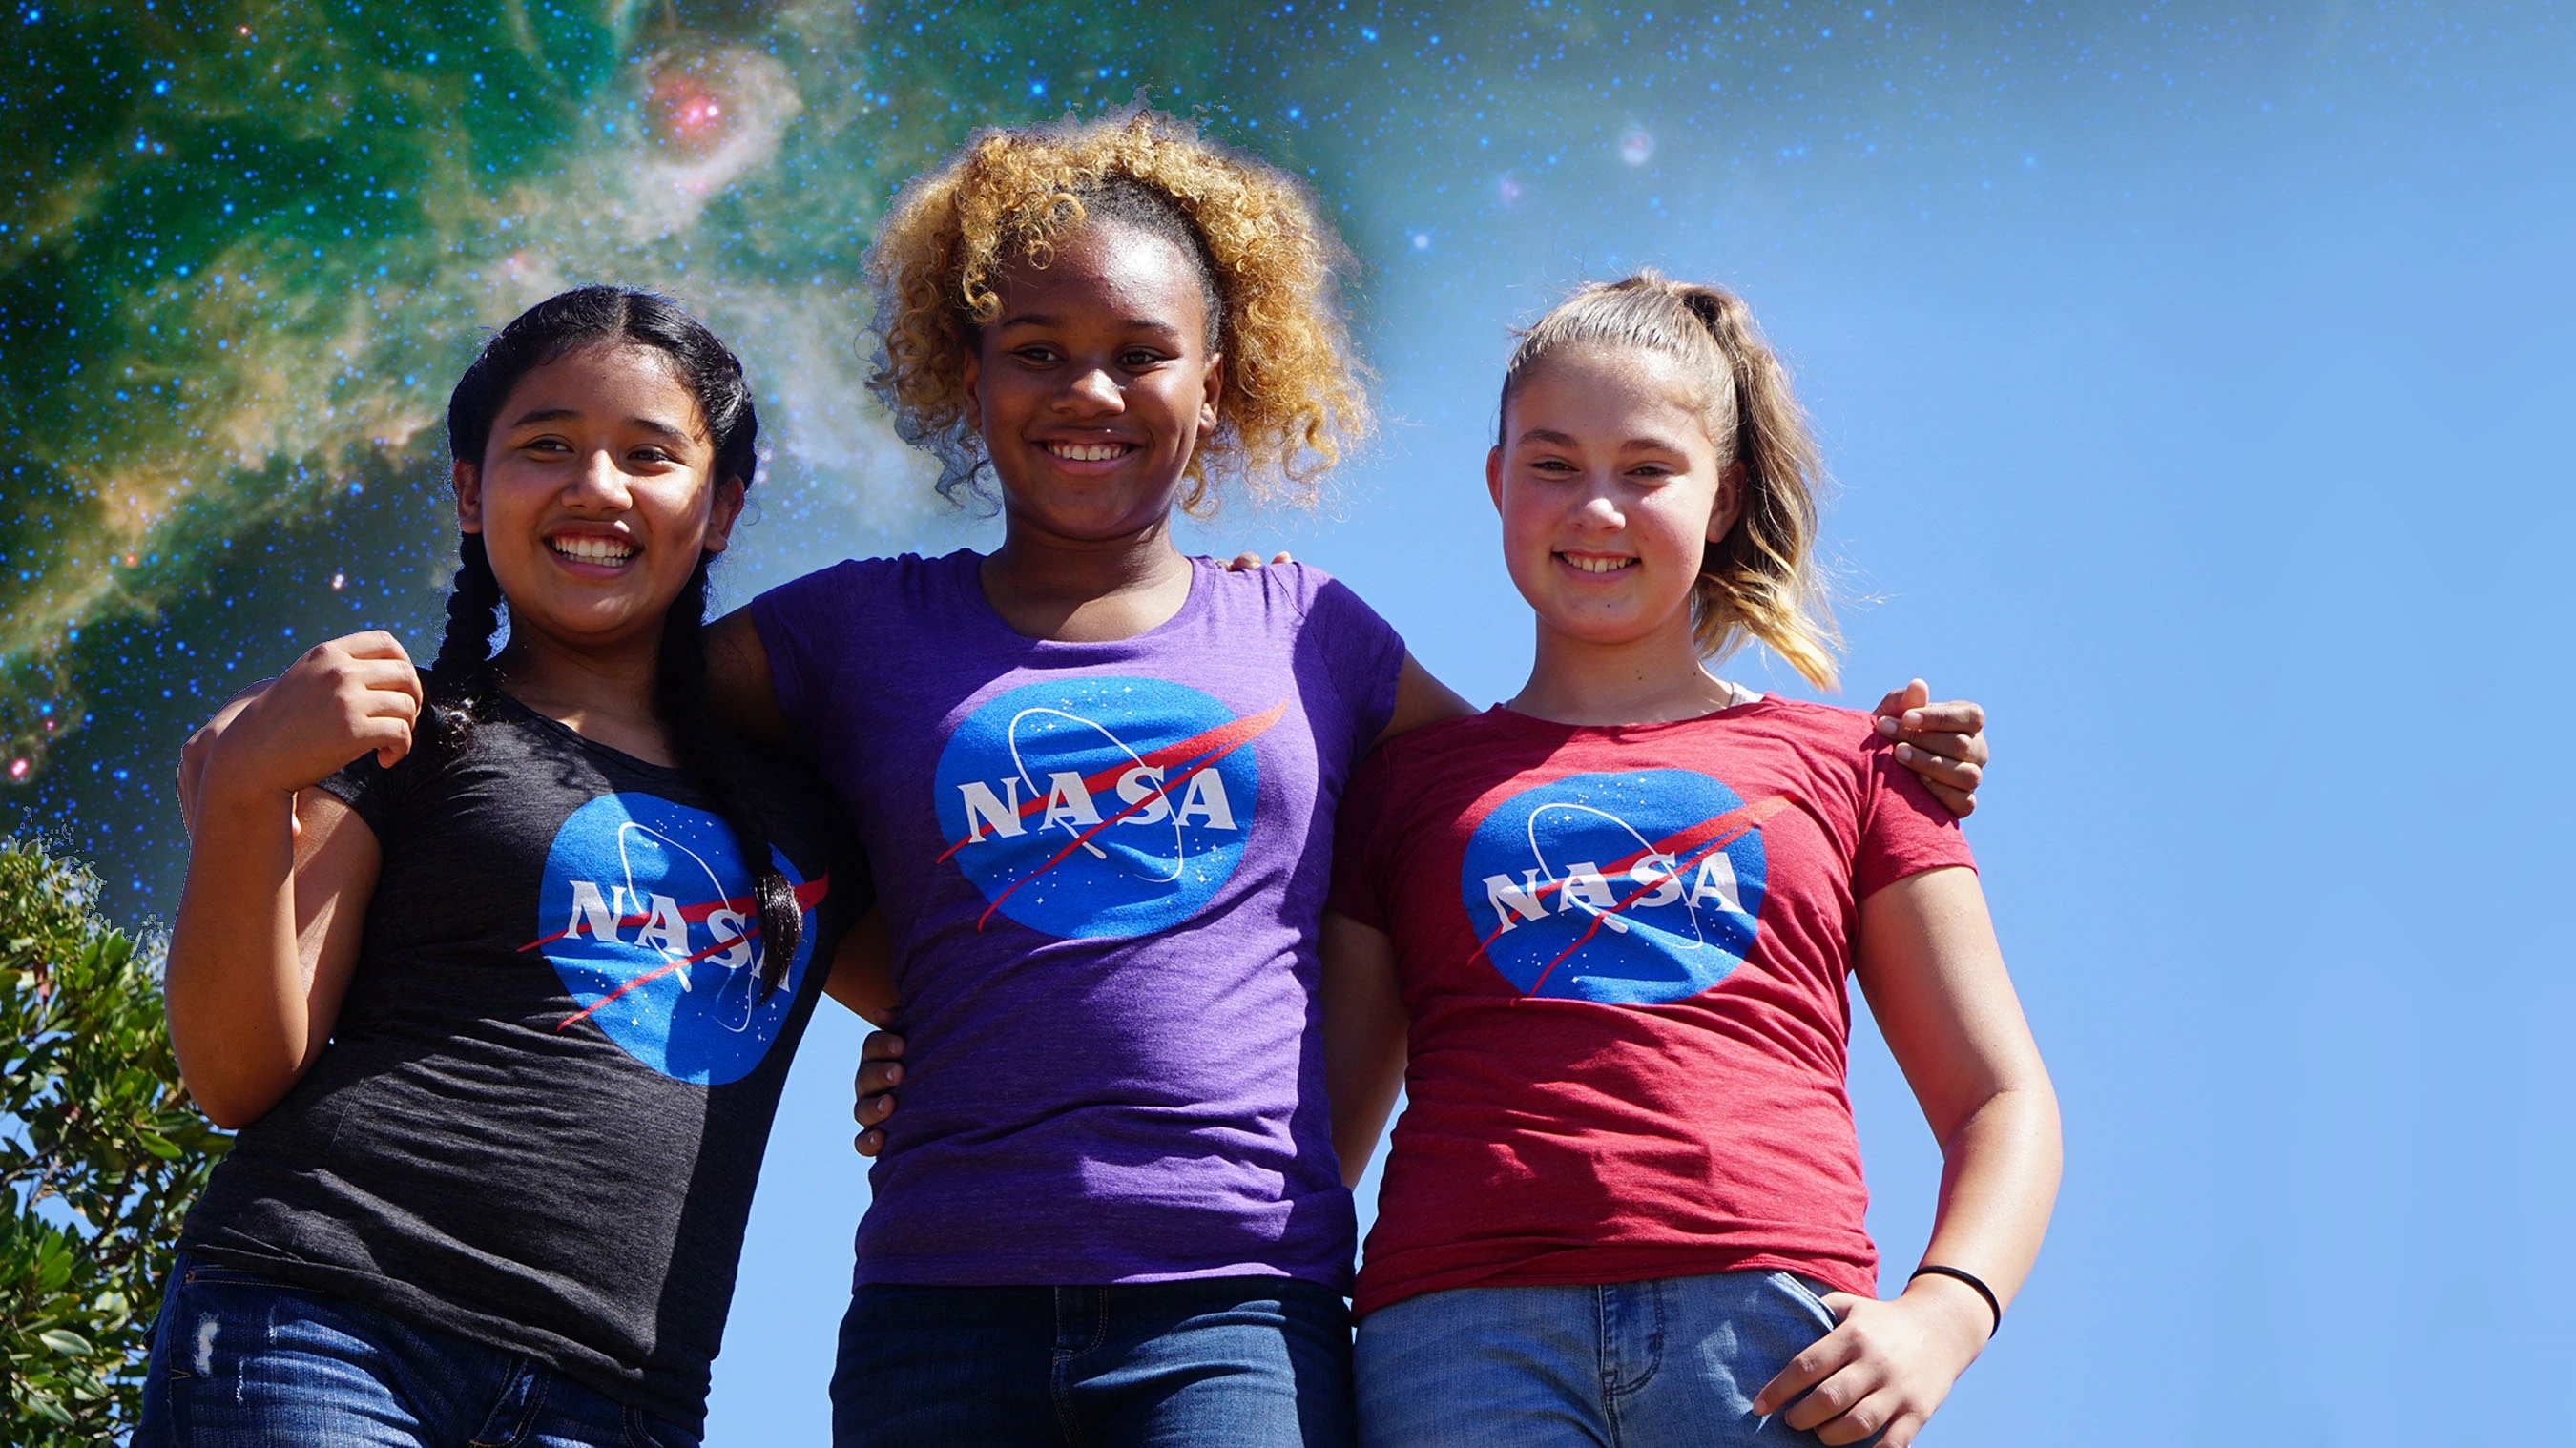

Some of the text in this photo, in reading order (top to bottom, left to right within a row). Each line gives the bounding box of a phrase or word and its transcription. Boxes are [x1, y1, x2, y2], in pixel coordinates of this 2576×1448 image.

[957, 765, 1238, 843] NASA
[1482, 851, 1748, 935] NASA
[563, 879, 791, 993] NAS
